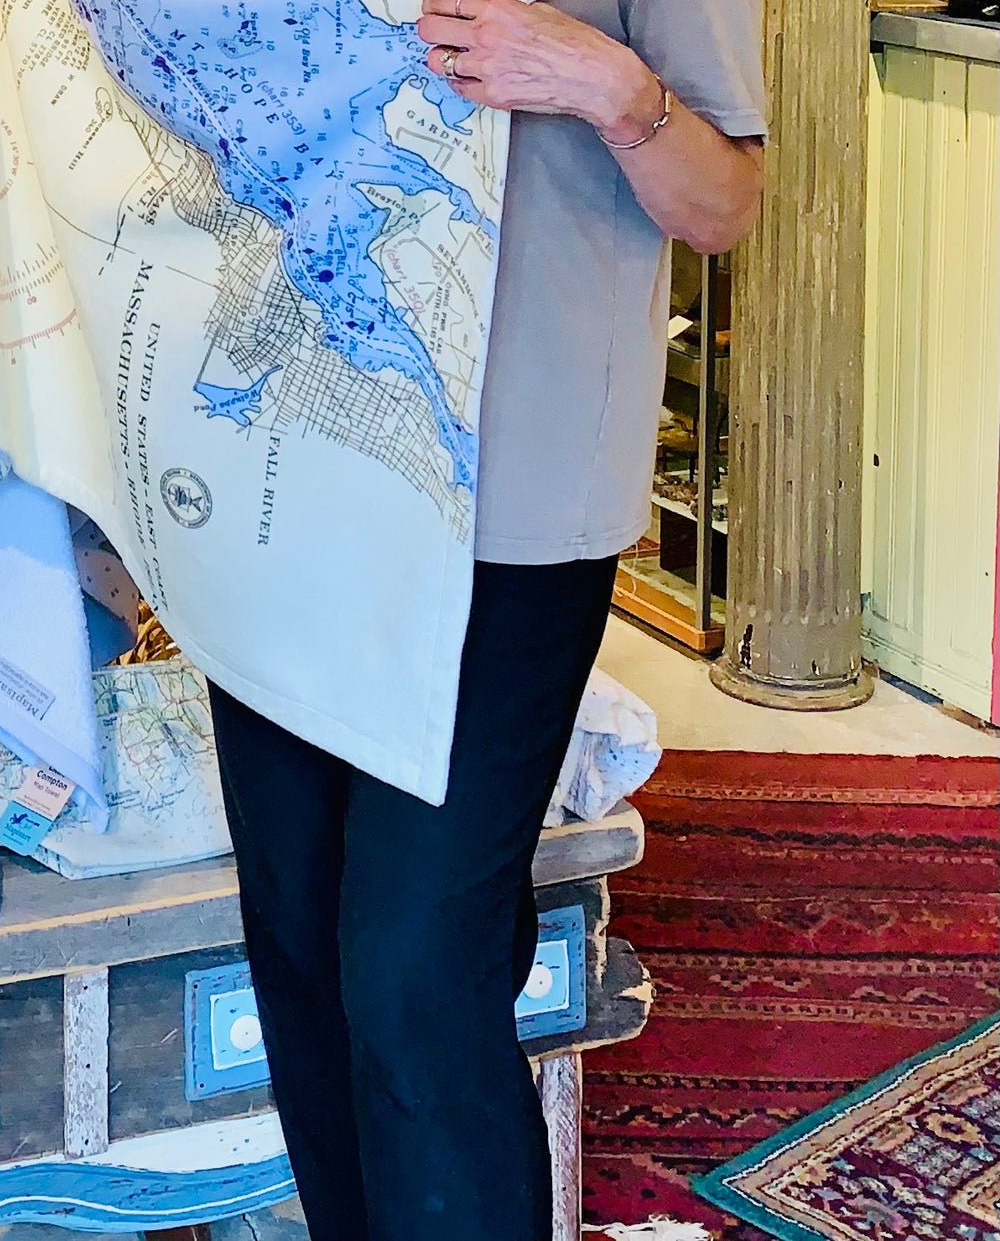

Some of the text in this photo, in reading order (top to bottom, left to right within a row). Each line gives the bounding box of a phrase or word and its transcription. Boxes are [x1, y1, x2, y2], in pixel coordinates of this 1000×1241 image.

[406, 41, 430, 55] Col
[224, 67, 280, 124] HOPE
[292, 143, 338, 179] BAY
[406, 109, 479, 161] GARDNER
[366, 185, 408, 213] Brayton
[116, 259, 154, 459] MASSACHUSETTS
[140, 323, 161, 402] UNITED
[138, 414, 150, 486] STATES
[258, 435, 282, 547] FALL RIVER
[145, 505, 157, 549] EAST
[36, 769, 68, 791] Compton
